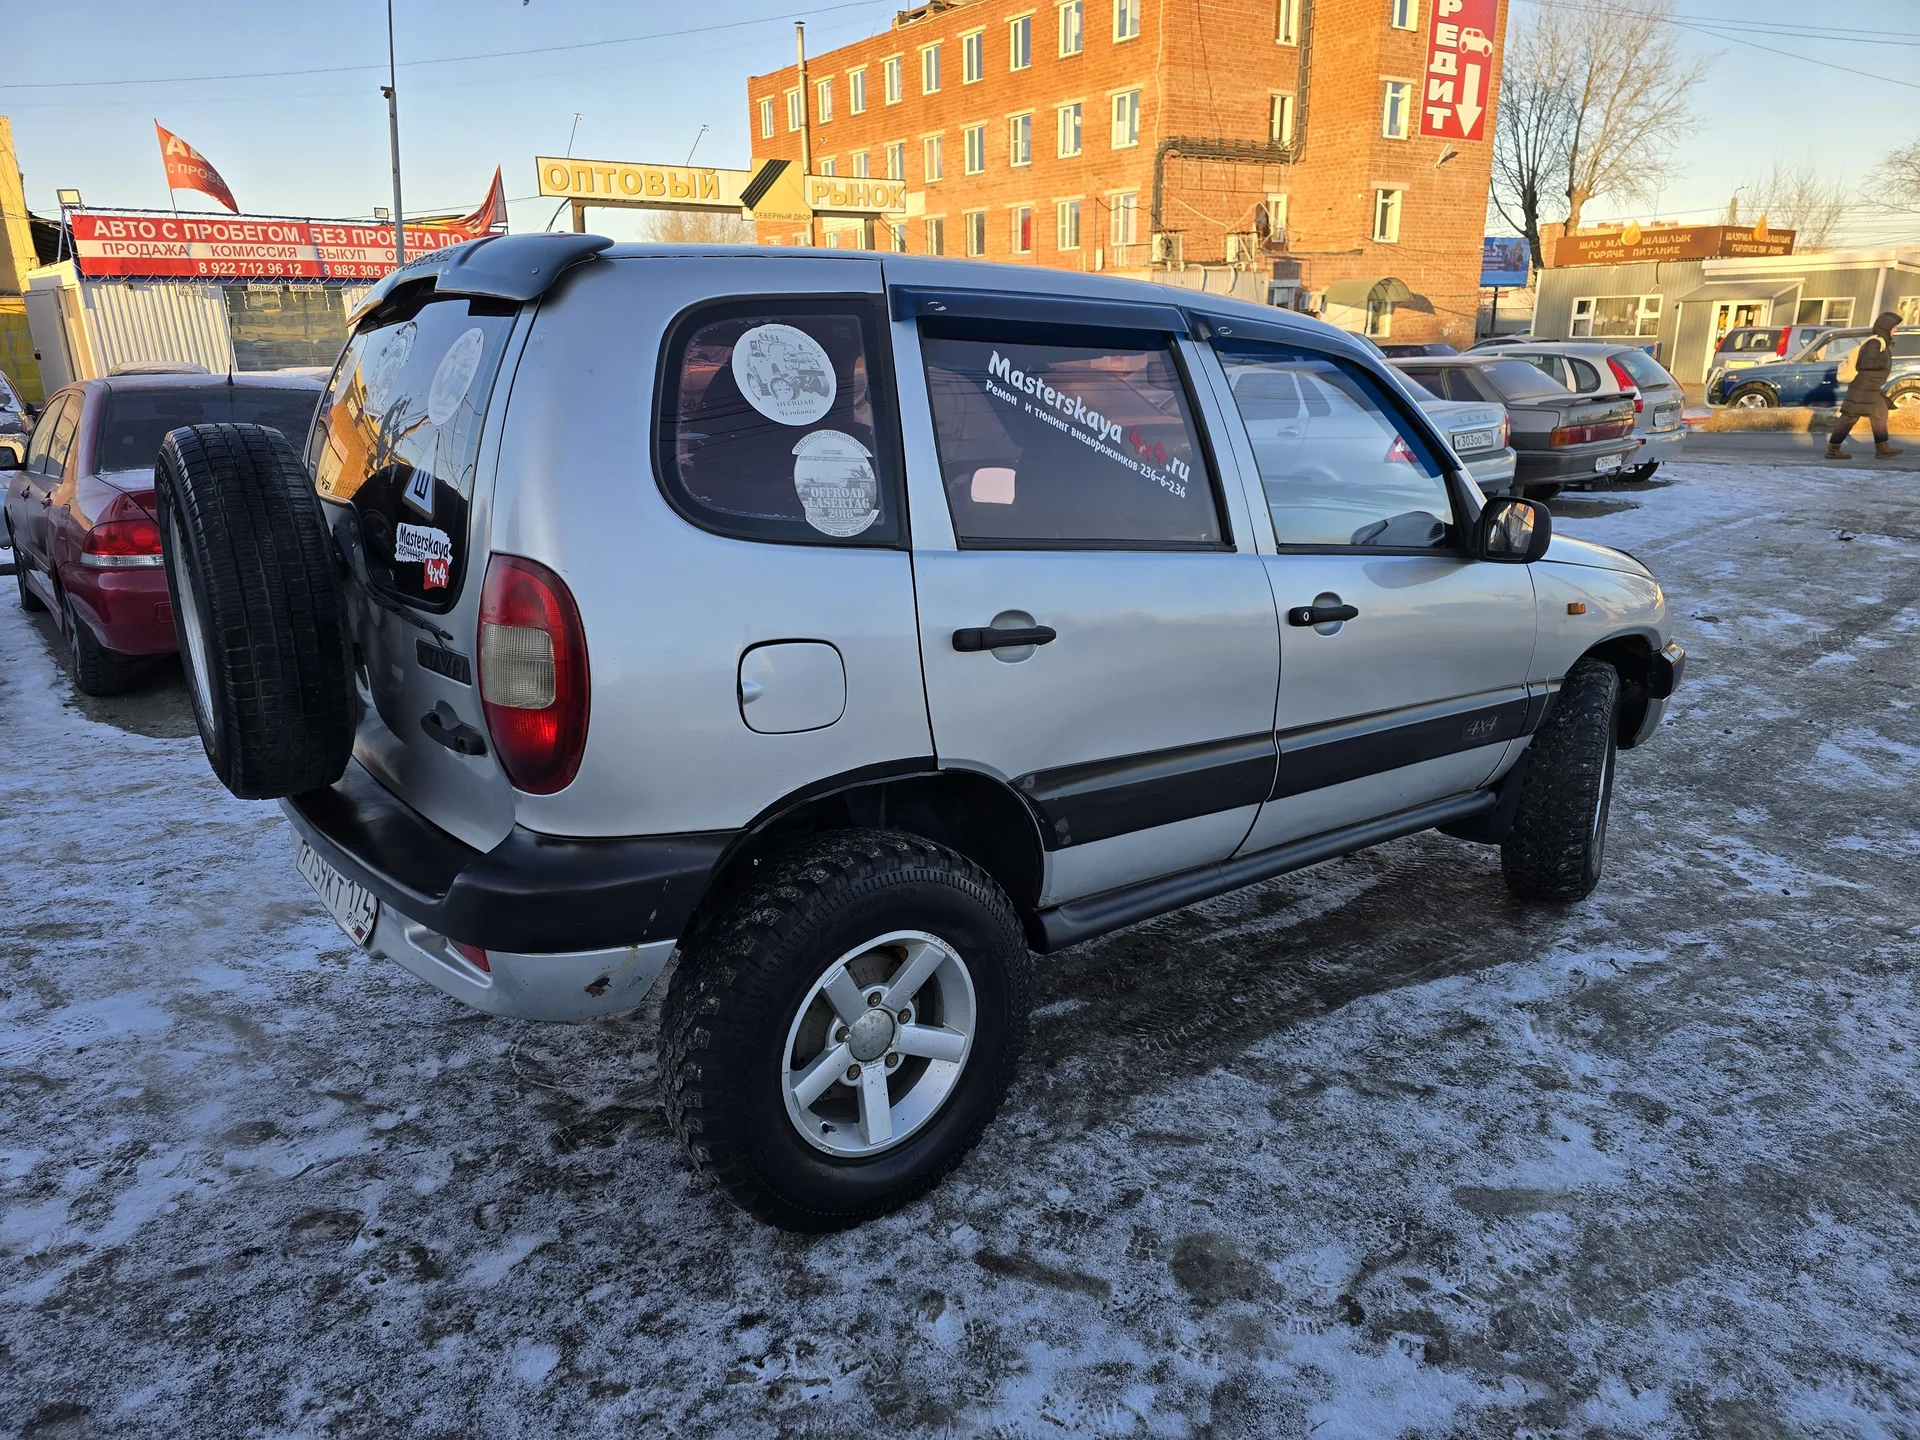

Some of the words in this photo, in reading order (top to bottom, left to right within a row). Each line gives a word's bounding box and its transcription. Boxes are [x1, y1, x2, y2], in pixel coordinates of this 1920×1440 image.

[167, 163, 175, 174] С
[544, 163, 720, 200] ОПТОВЫЙ
[811, 180, 905, 209] РЫНОК
[754, 211, 792, 220] СЕВЕРНЫЙ
[793, 213, 811, 221] ДВОР
[94, 221, 156, 239] АВТО
[162, 222, 178, 240] С
[183, 222, 305, 245] ПРОБЕГОМ,
[310, 227, 347, 245] БЕЗ
[1642, 234, 1691, 246] ШАШЛЫК
[102, 242, 188, 258] ПРОДАЖА
[211, 245, 298, 259] КОМИССИЯ
[317, 248, 367, 261] ВЫКУП
[1588, 249, 1625, 259] ГОРЯЧЕ
[1632, 246, 1680, 257] ПИТАНИЕ
[198, 262, 208, 274] 8
[211, 262, 236, 274] 922
[240, 262, 264, 275] 712
[268, 262, 284, 275] 96
[287, 263, 303, 275] 12
[323, 264, 331, 275] 8
[335, 264, 357, 276] 982
[360, 264, 381, 276] 305
[776, 399, 814, 408] OFFROAD
[987, 350, 1123, 445] Masterskaya
[1024, 402, 1032, 414] и
[1034, 407, 1069, 433] тюнинг
[1071, 426, 1138, 472] внедорожников
[1140, 463, 1186, 499] 236-6-236
[810, 486, 866, 499] OFFROAD
[807, 497, 870, 509] LASERTAG
[827, 508, 854, 519] 2018
[399, 523, 449, 560] Masterskaya
[427, 559, 447, 586] 4x4
[344, 911, 359, 931] RUS
